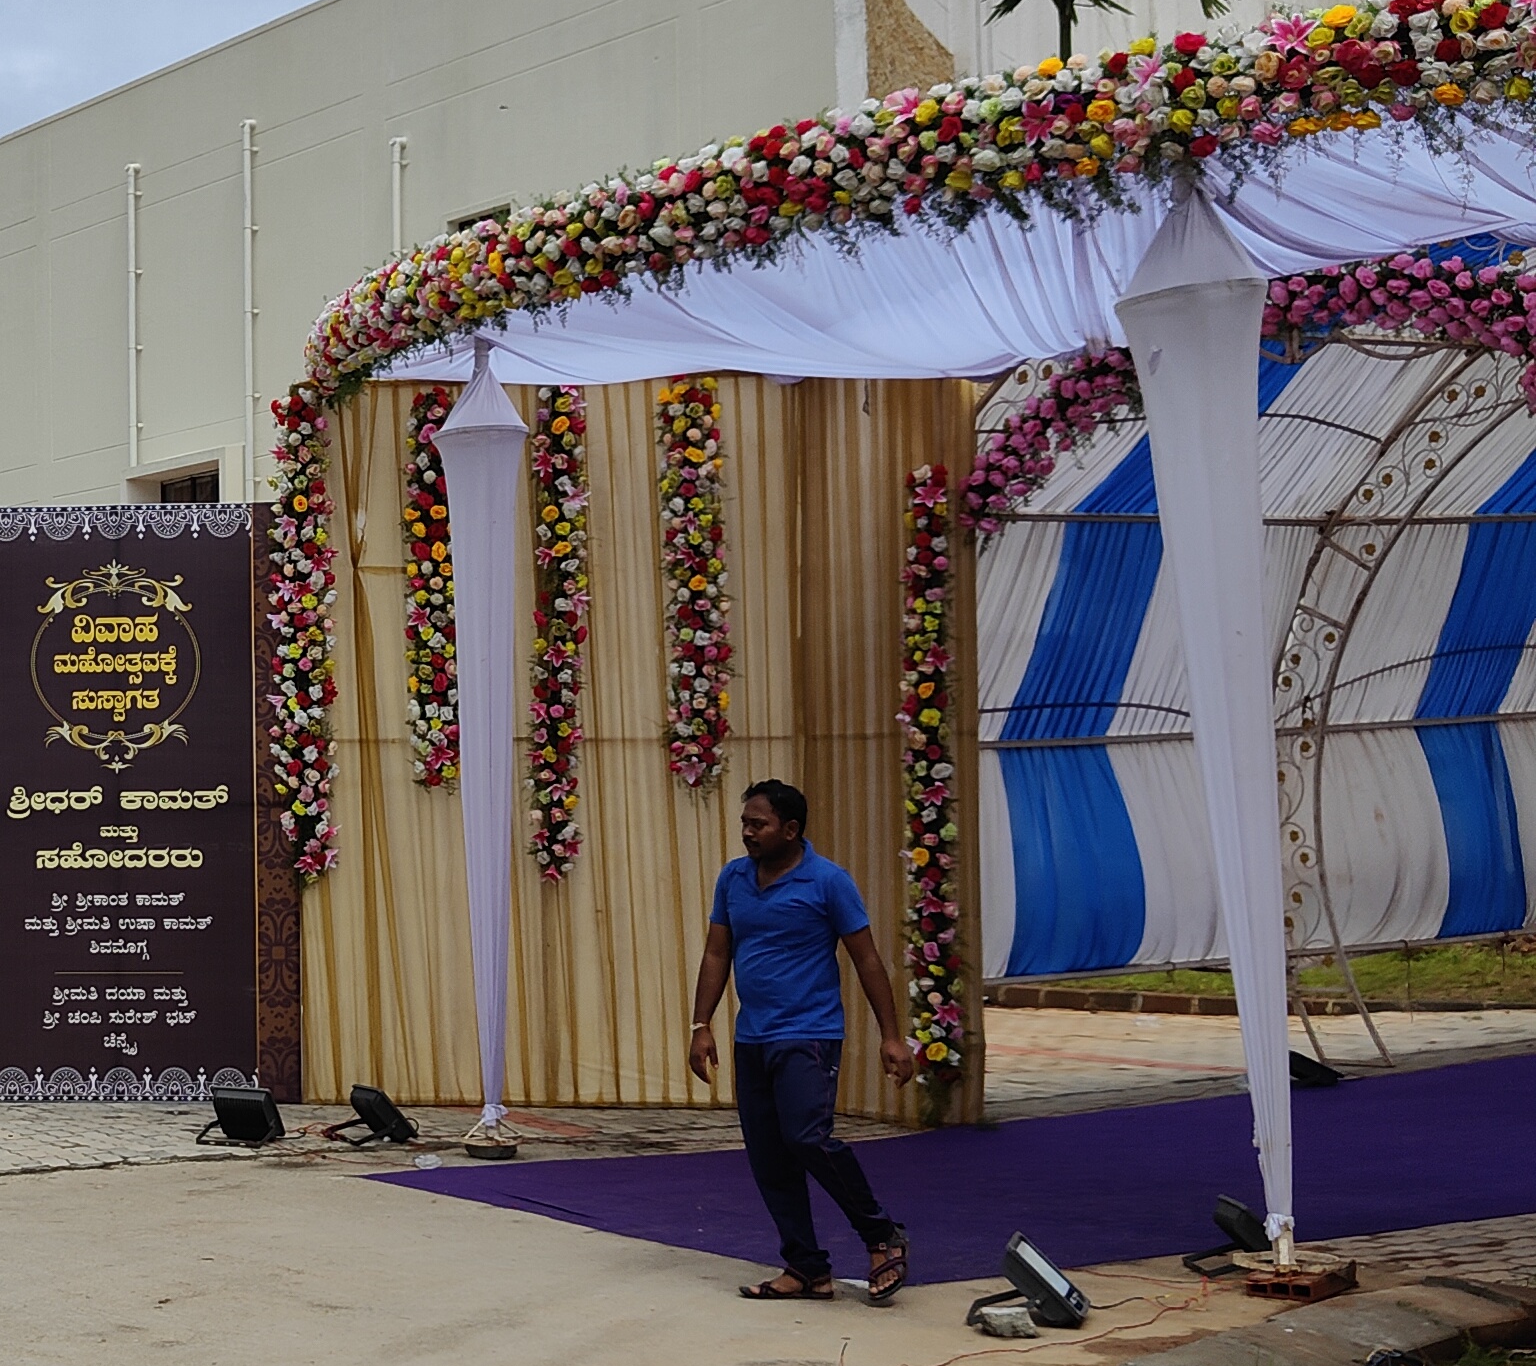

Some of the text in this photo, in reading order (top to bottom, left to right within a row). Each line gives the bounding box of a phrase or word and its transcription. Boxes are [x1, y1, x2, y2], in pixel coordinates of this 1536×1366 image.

[70, 612, 160, 643] ವಿವಾಹ
[53, 645, 178, 685] ಮಹೋತ್ಸವಕ್ಕೆ
[71, 687, 161, 723] ಸುಸ್ವಾಗತ
[6, 784, 229, 819] ಶ್ರೀಧರ್ ಕಾಮತ್
[99, 825, 139, 843] ಮತ್ತು
[35, 841, 204, 869] ಸಹೋದರರು
[50, 891, 186, 912] ಶ್ರೀ ಶ್ರೀಕಾಂತ ಕಾಮತ್
[24, 915, 213, 937] ಮತ್ತು ಶ್ರೀಮತಿ ಉಷಾ ಕಾಮತ್
[89, 938, 150, 961] ಶಿವಮೊಗ್ಗ
[52, 986, 189, 1007] ಶ್ರೀಮತಿ ದಯಾ ಮತ್ತು
[42, 1010, 61, 1030] ಶ್ರೀ
[108, 1009, 159, 1025] ಸುರೇಶ್
[165, 1010, 197, 1027] ಭಟ್
[103, 1032, 138, 1056] ಚೆನ್ನೈ
